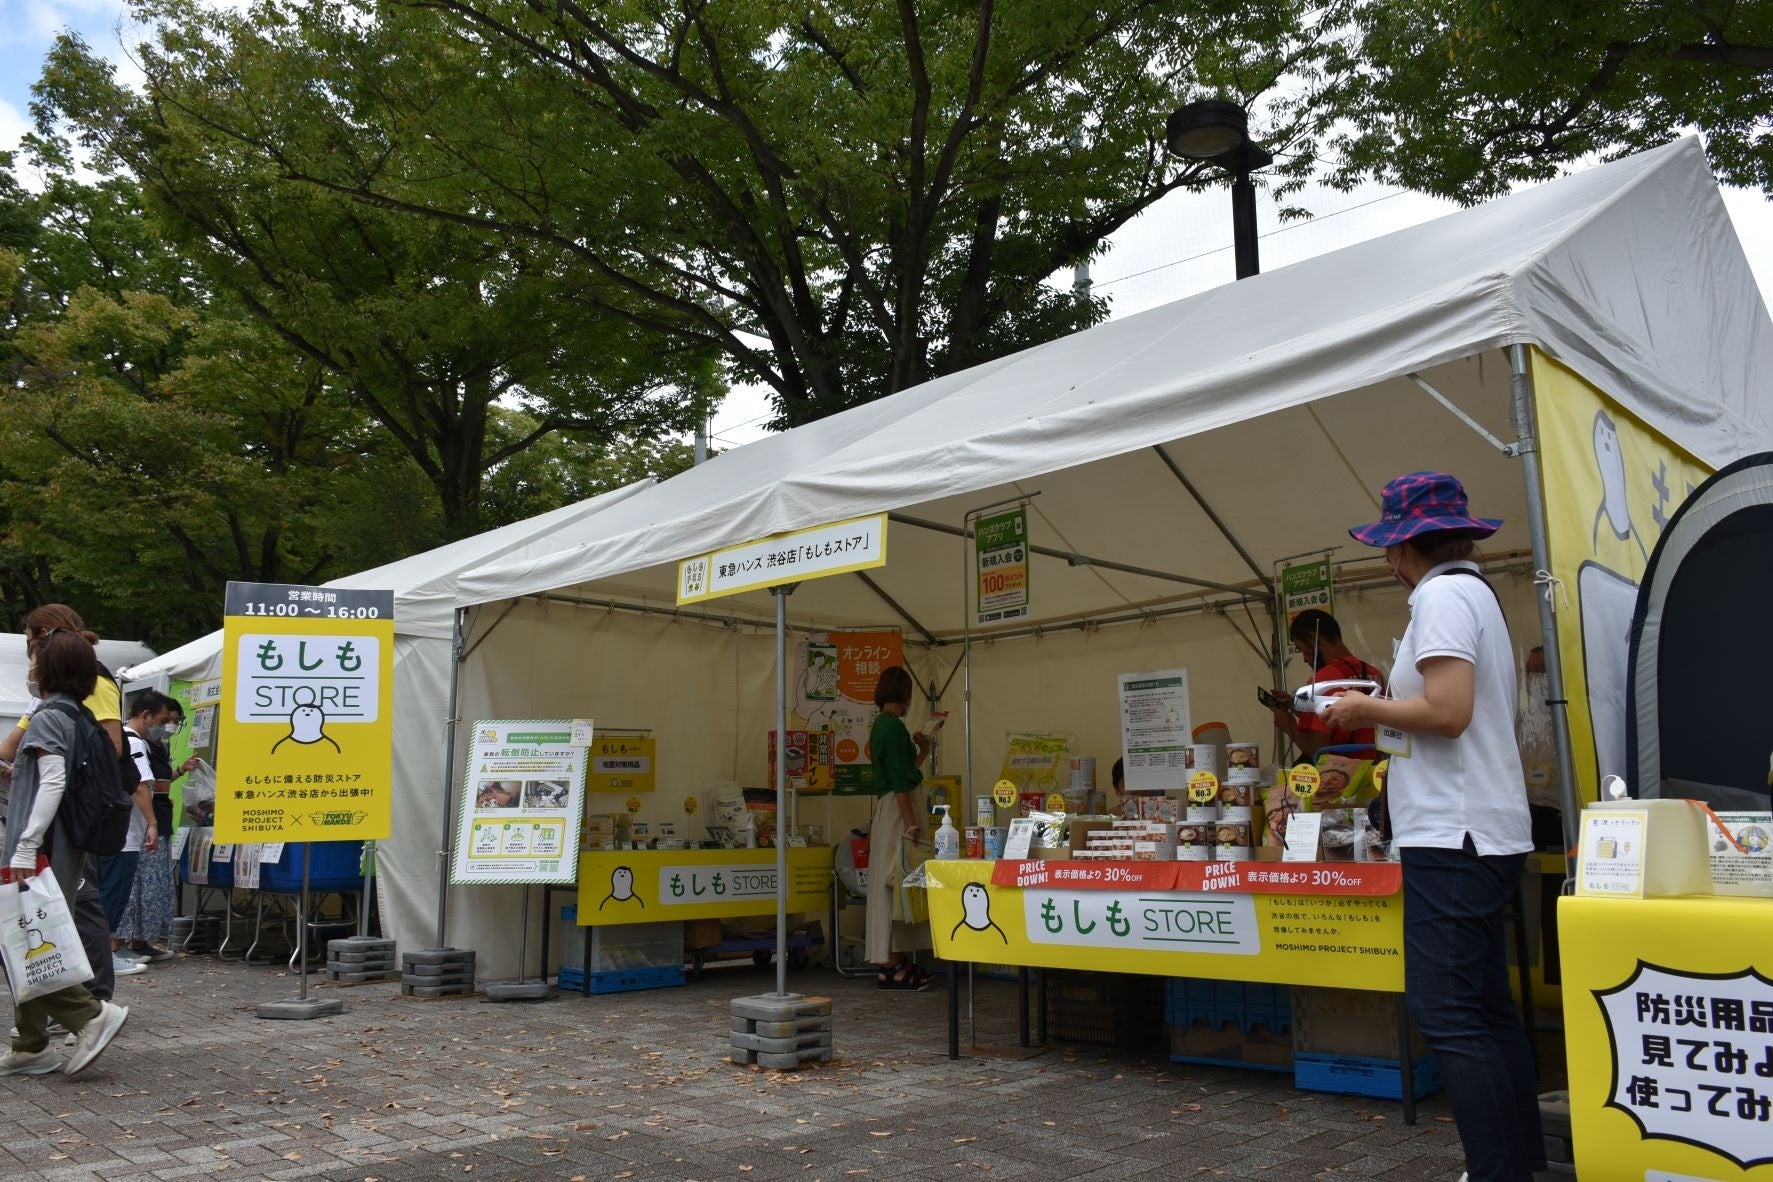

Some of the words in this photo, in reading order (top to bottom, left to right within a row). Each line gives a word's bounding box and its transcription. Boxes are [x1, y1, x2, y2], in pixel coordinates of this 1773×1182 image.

[718, 554, 764, 579] 東急ハンズ
[982, 574, 1004, 594] 100
[288, 590, 336, 602] 営業時間
[245, 602, 298, 616] 11:00
[327, 606, 378, 618] 16:00
[256, 639, 362, 672] もしも
[842, 645, 892, 660] オンライン
[254, 686, 360, 708] STORE
[245, 774, 362, 785] もしもに備える防災ストア
[1196, 788, 1211, 798] No.3
[1295, 784, 1312, 794] No.2
[242, 824, 284, 832] SHIBUYA
[1020, 860, 1046, 874] PRICE
[1054, 869, 1101, 880] 表示価格より
[1205, 862, 1236, 878] PRICE
[670, 872, 726, 897] もしも
[1017, 872, 1048, 886] DOWN!
[1202, 874, 1240, 891] DOWN!
[1248, 872, 1308, 884] 表示価格より
[1040, 898, 1130, 937] もしも
[1143, 908, 1234, 935] STORE
[1276, 944, 1316, 952] MOSHIMO
[1318, 946, 1356, 954] PROJECT
[1360, 947, 1398, 956] SHIBUYA
[25, 952, 62, 971] MOSHIMO
[26, 960, 63, 978] PROJECT
[28, 966, 66, 986] SHIBUYA
